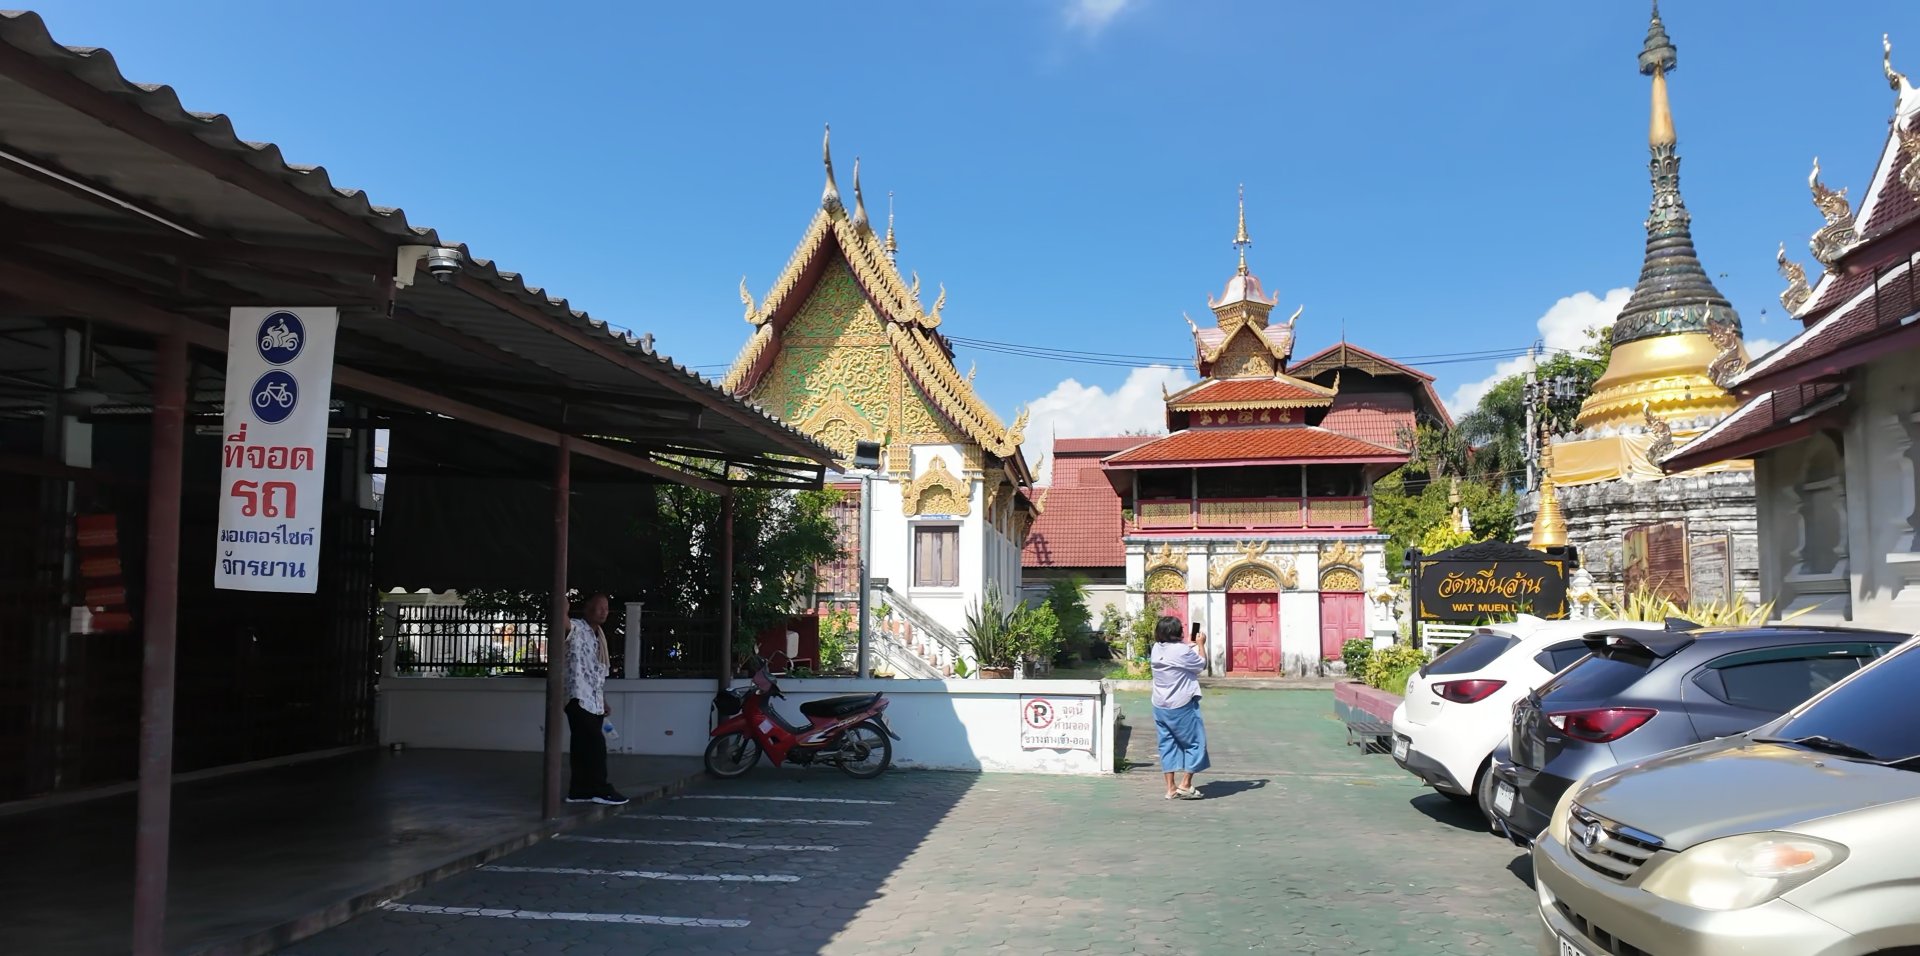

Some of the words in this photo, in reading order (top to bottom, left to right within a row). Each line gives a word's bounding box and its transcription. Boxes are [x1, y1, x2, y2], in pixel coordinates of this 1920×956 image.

[224, 423, 314, 471] ที่จอด
[230, 479, 297, 519] รถ
[221, 550, 306, 578] จักรยาน
[1438, 562, 1545, 598] วัดหมื่นล้าน
[1452, 603, 1474, 612] WAT
[1478, 603, 1508, 612] MUEN
